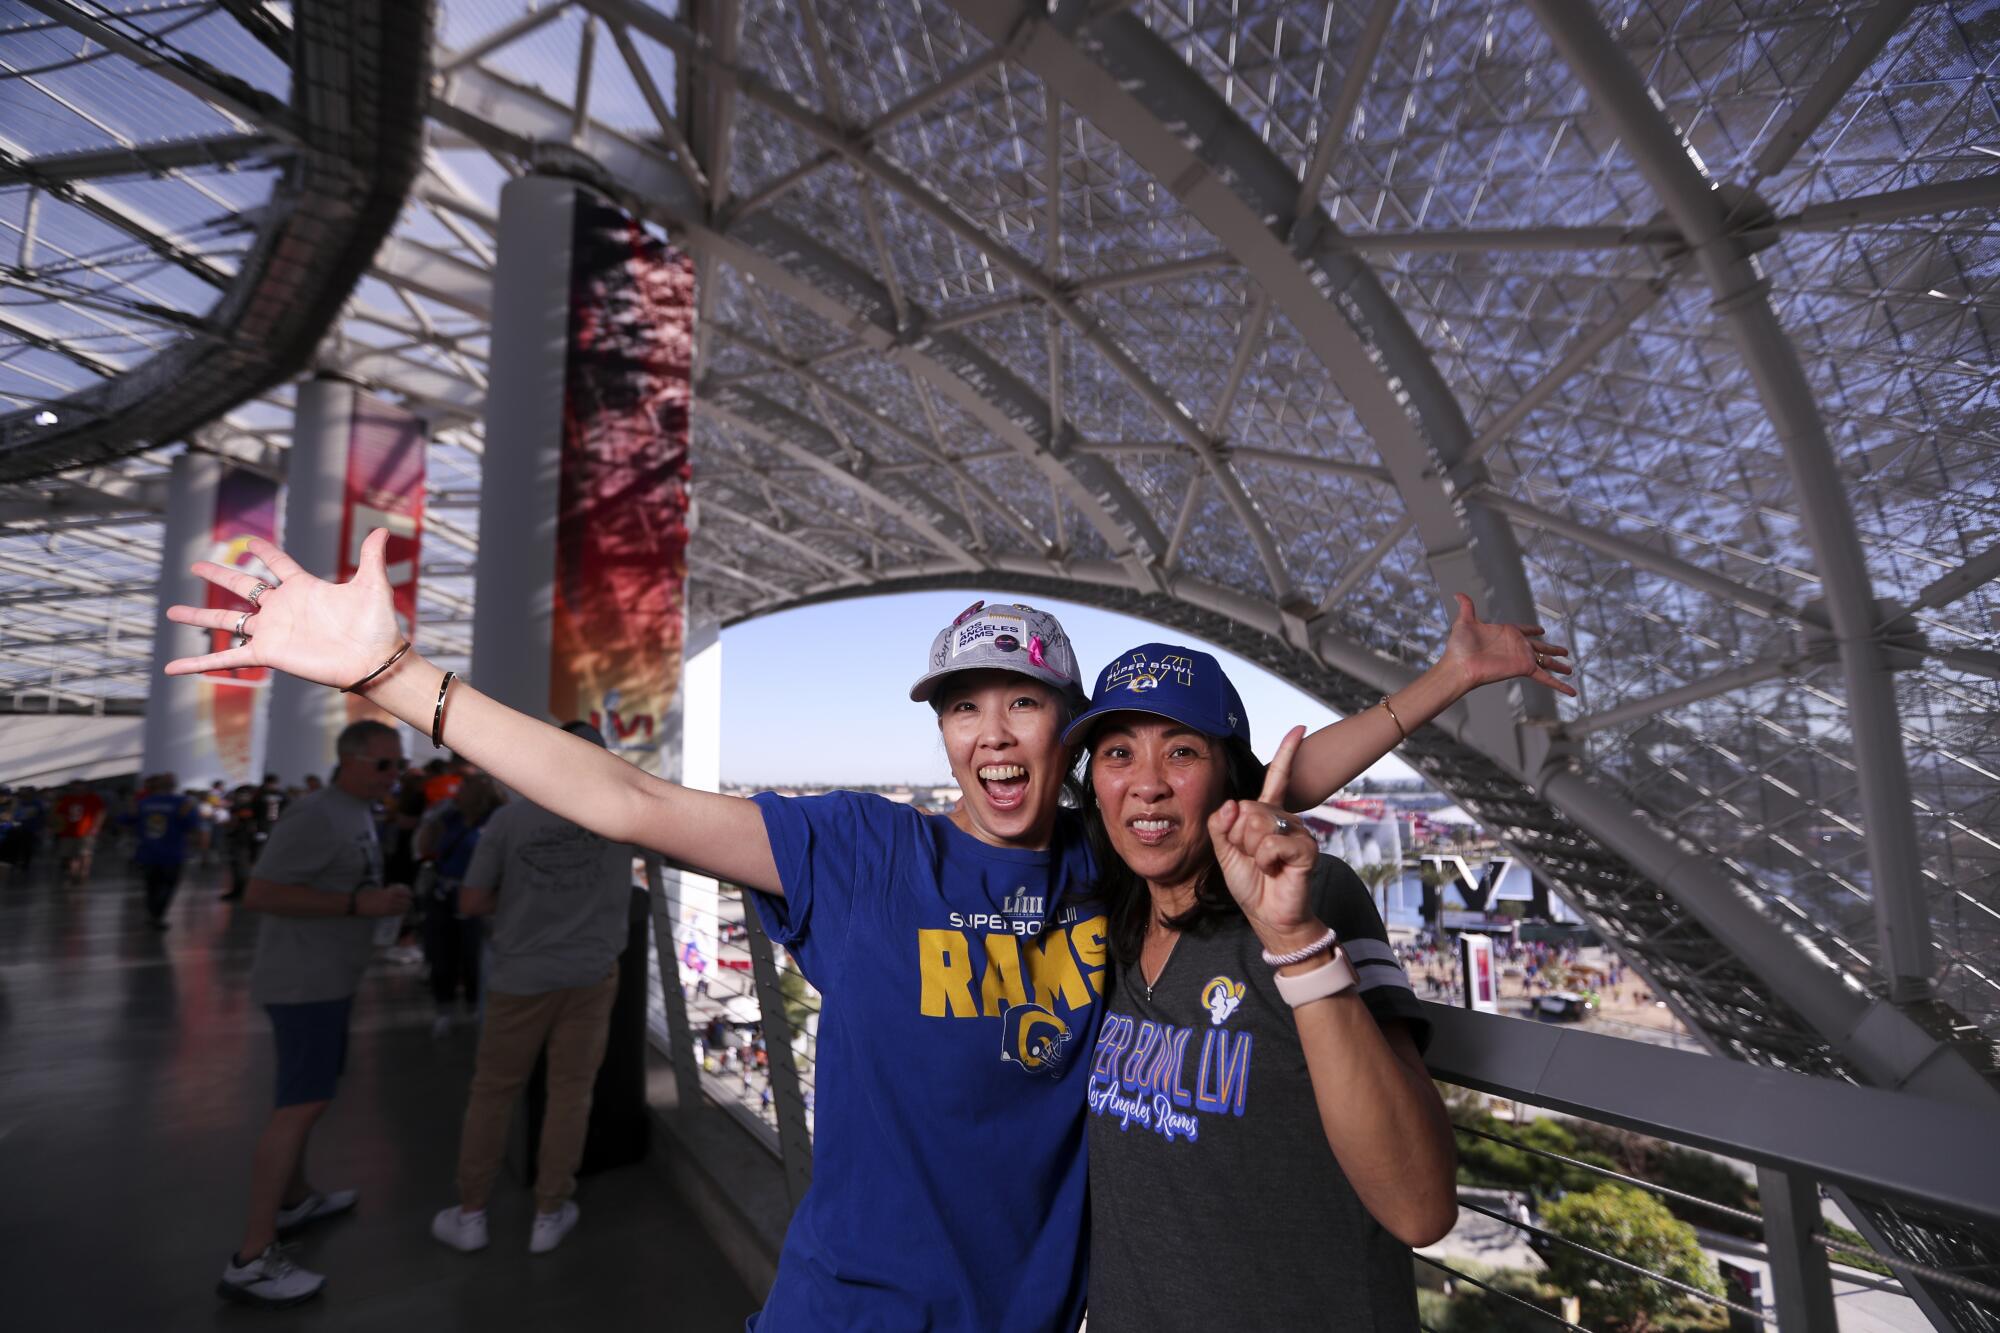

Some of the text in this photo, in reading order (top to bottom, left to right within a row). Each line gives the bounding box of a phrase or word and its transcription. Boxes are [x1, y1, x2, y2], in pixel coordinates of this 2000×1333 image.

[960, 625, 1018, 641] ANGELES
[961, 621, 982, 635] LOS
[960, 630, 994, 647] RAMS
[1106, 662, 1194, 681] SUPER BOWL
[918, 915, 1108, 1018] RAMS
[1123, 1021, 1192, 1105] BOWL
[1197, 1030, 1252, 1114] LVI
[1098, 1080, 1151, 1127] Angeles
[1153, 1094, 1197, 1137] Rams
